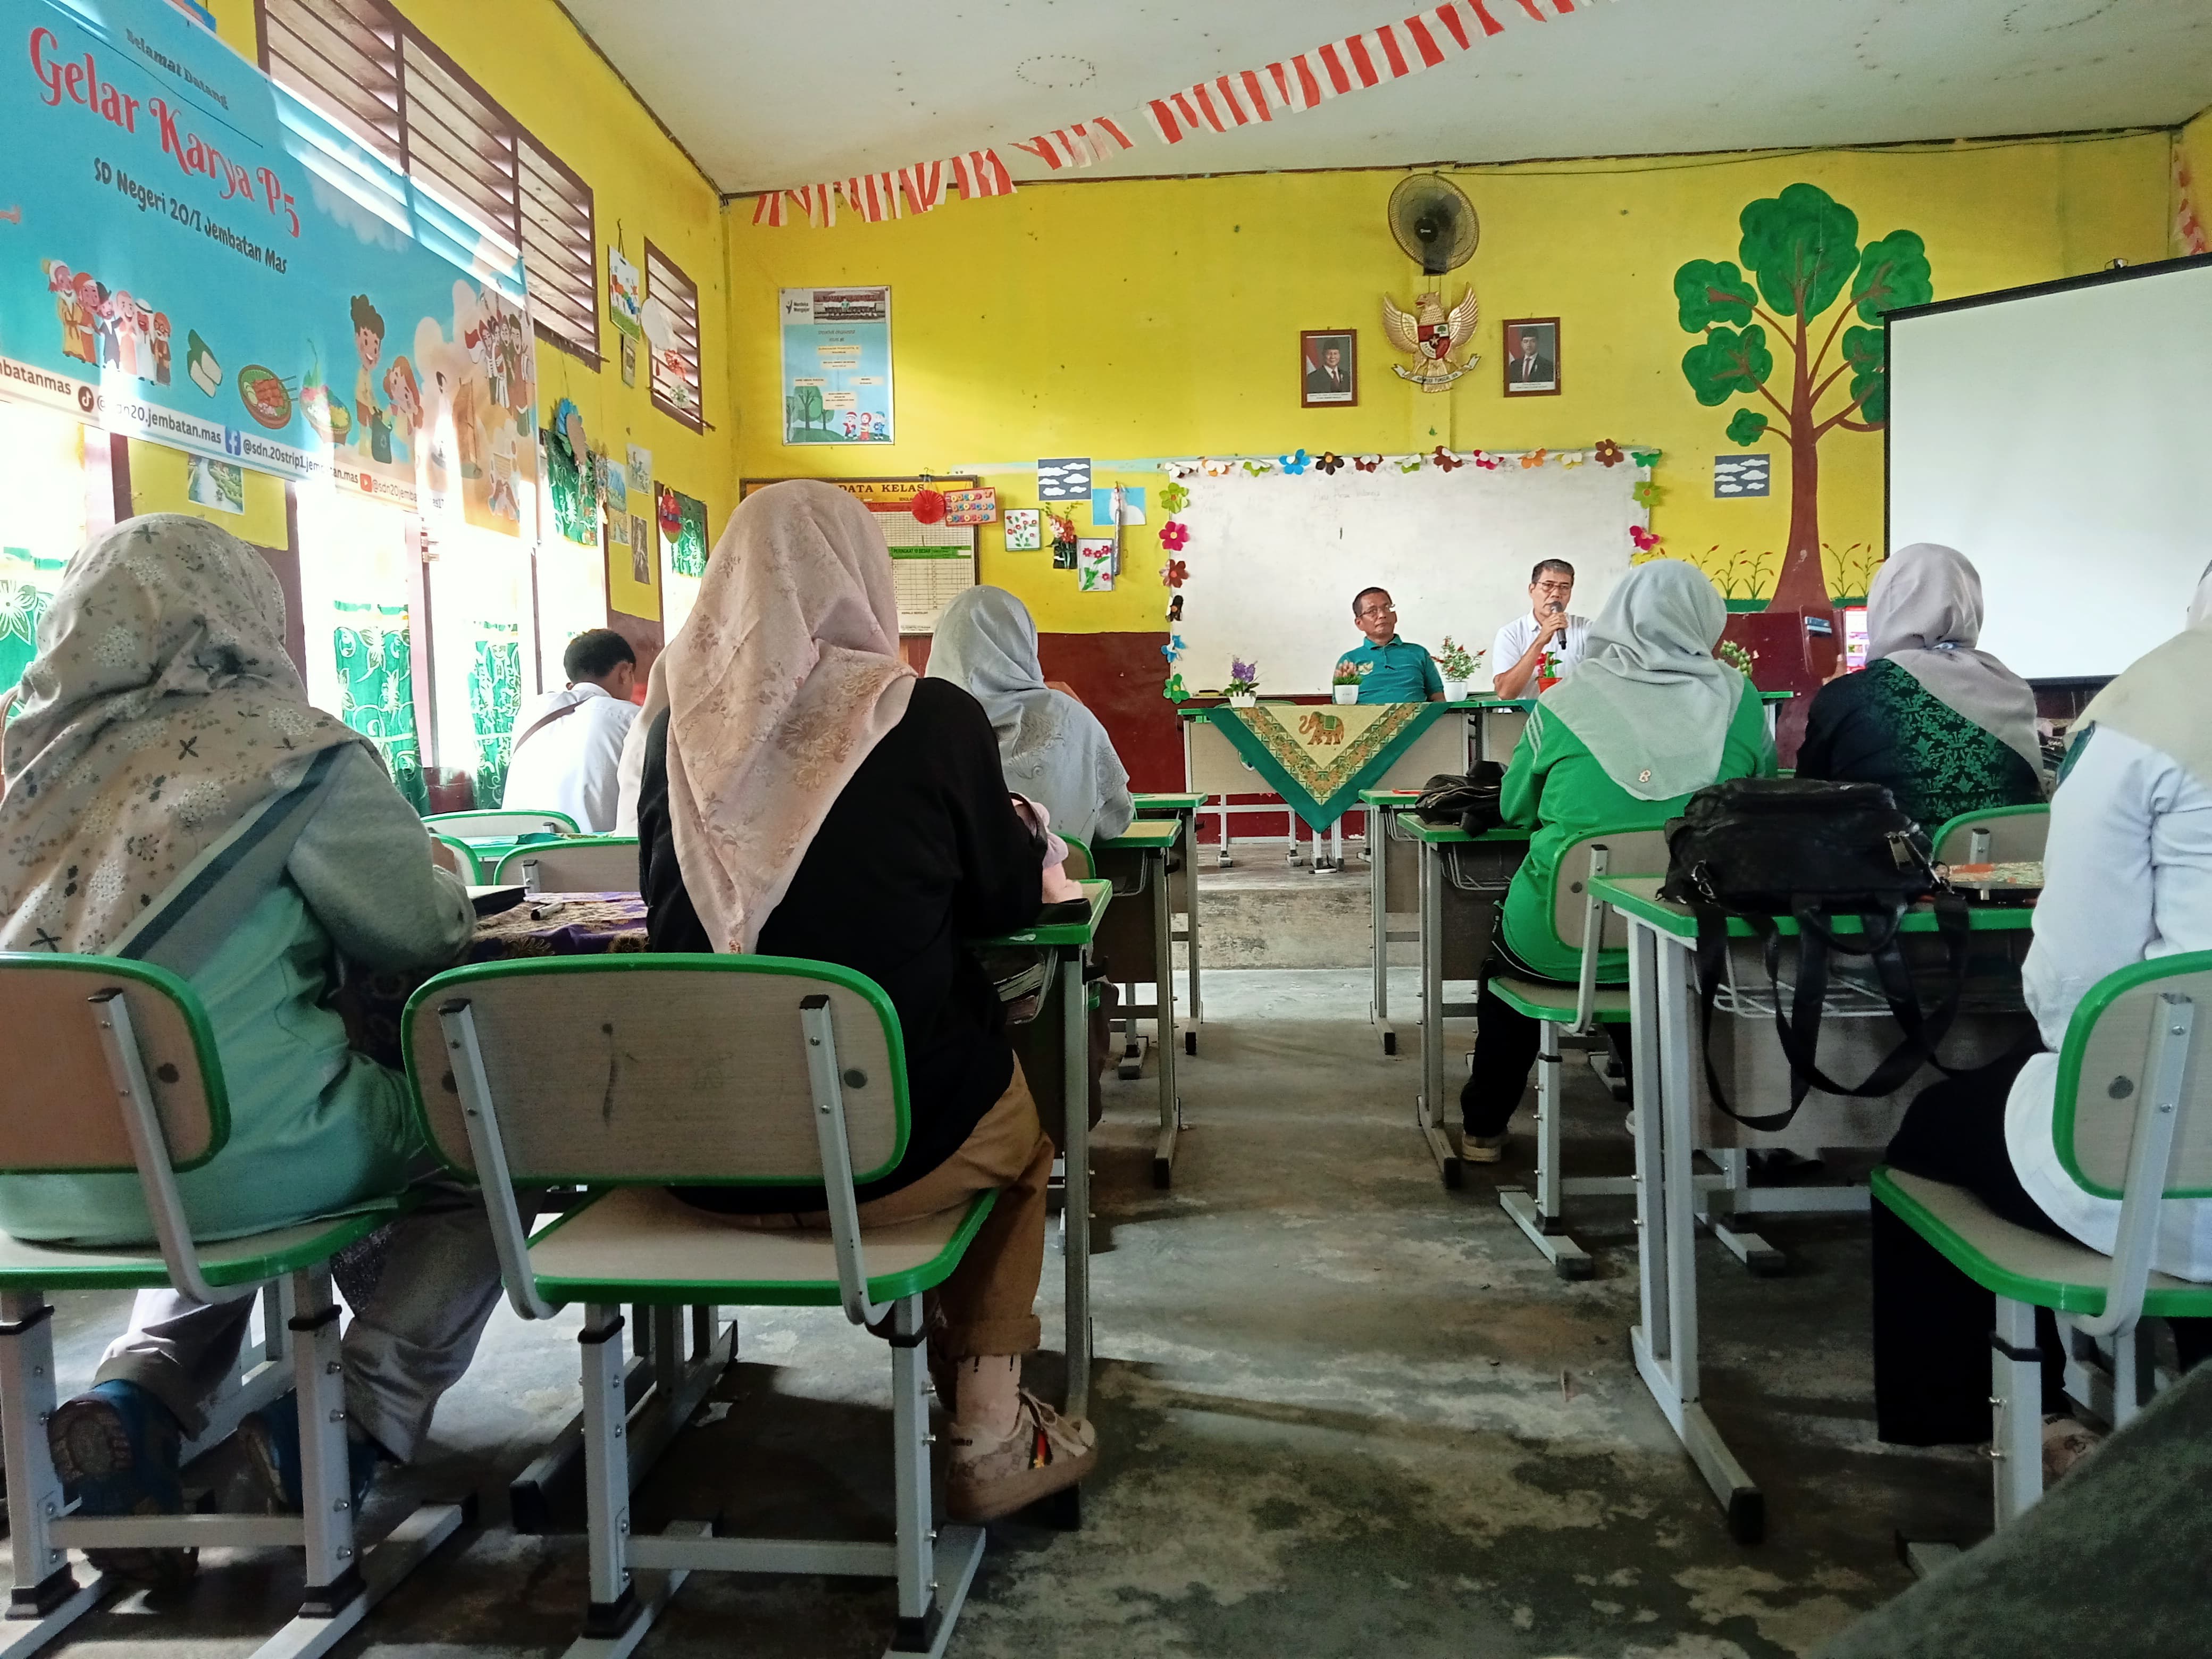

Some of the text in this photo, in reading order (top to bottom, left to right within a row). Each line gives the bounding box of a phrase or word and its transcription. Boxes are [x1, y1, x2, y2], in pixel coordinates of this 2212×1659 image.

[184, 68, 229, 111] Datang
[30, 27, 300, 238] Gelar Karya P5
[95, 157, 112, 184] SD
[118, 171, 166, 214] Negeri
[204, 215, 262, 263] Jembatan
[265, 246, 287, 274] Mas
[97, 395, 222, 444] @n20.jembatan.mas
[243, 439, 358, 483] @sdn.20strip1.jeman.mas
[882, 484, 924, 492] KELAS
